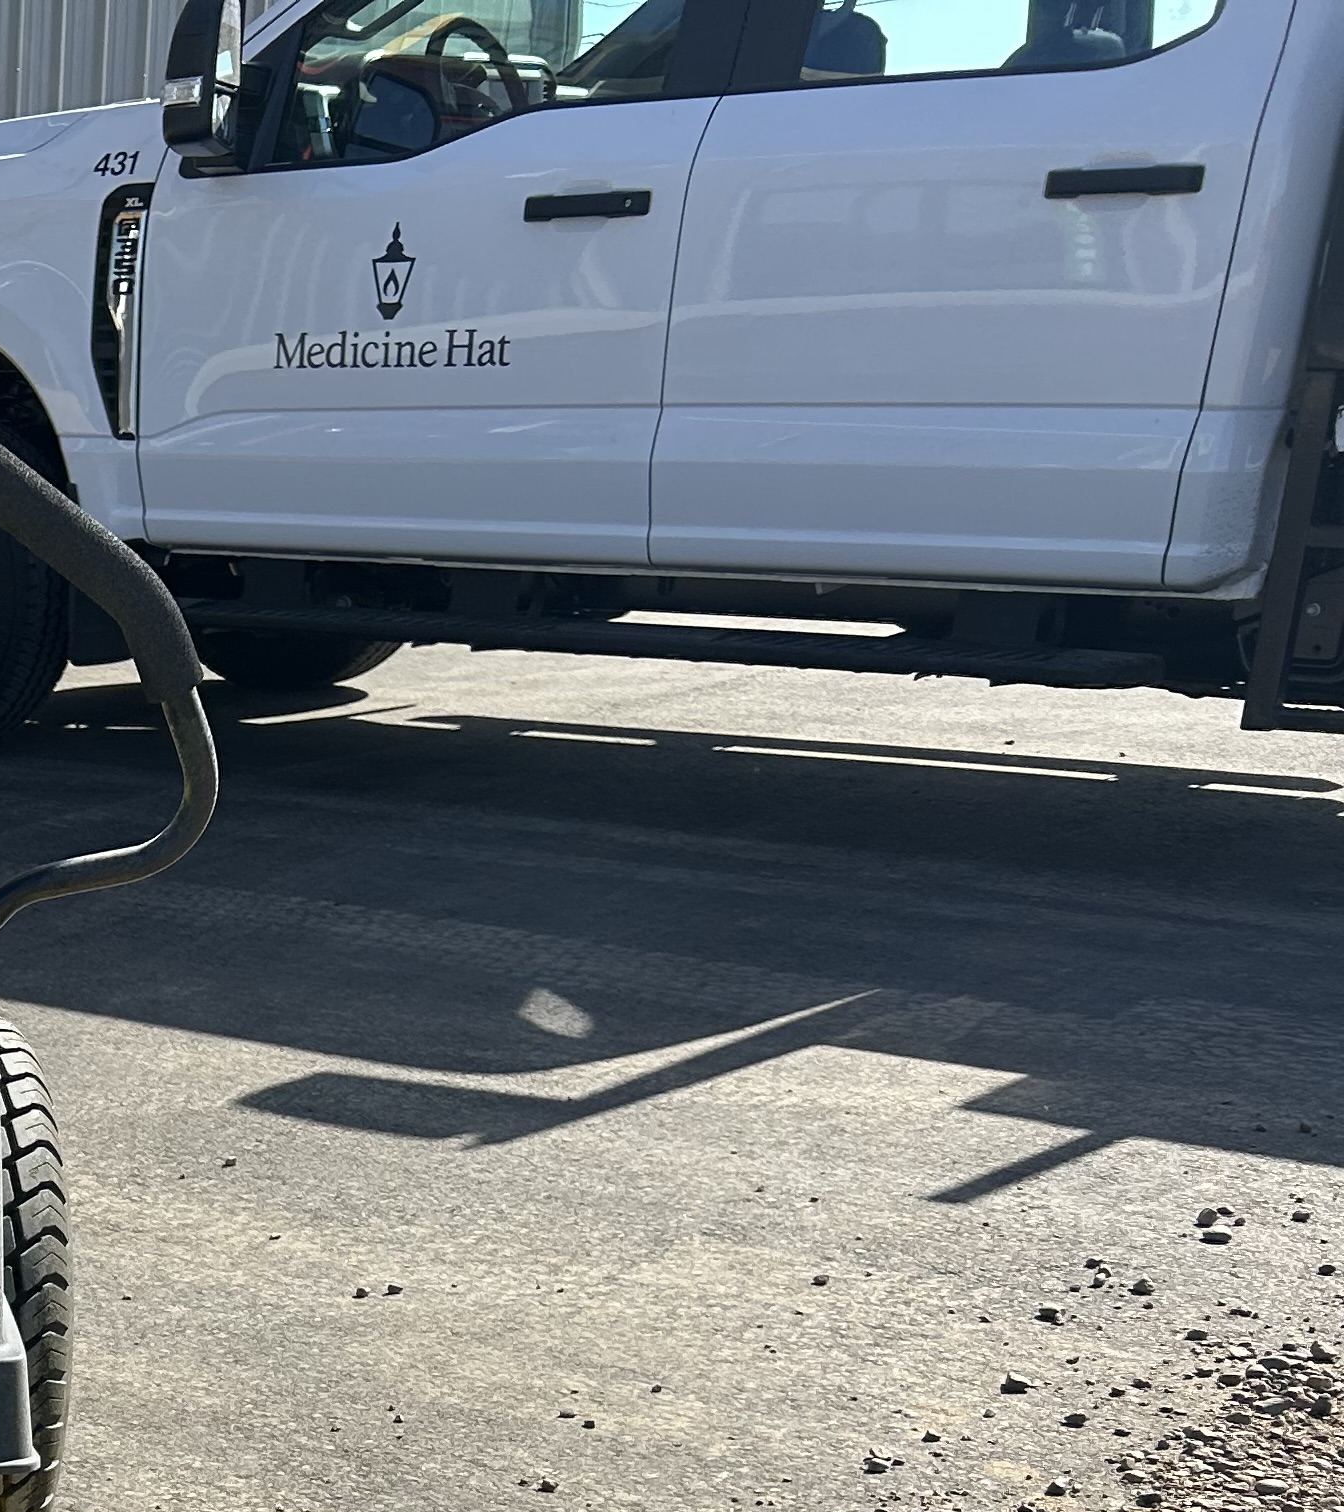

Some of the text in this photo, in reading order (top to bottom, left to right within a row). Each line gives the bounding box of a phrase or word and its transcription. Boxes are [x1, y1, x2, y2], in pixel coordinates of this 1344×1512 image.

[93, 151, 140, 177] 431
[125, 197, 144, 208] XL
[274, 328, 511, 370] Medicine Hat
